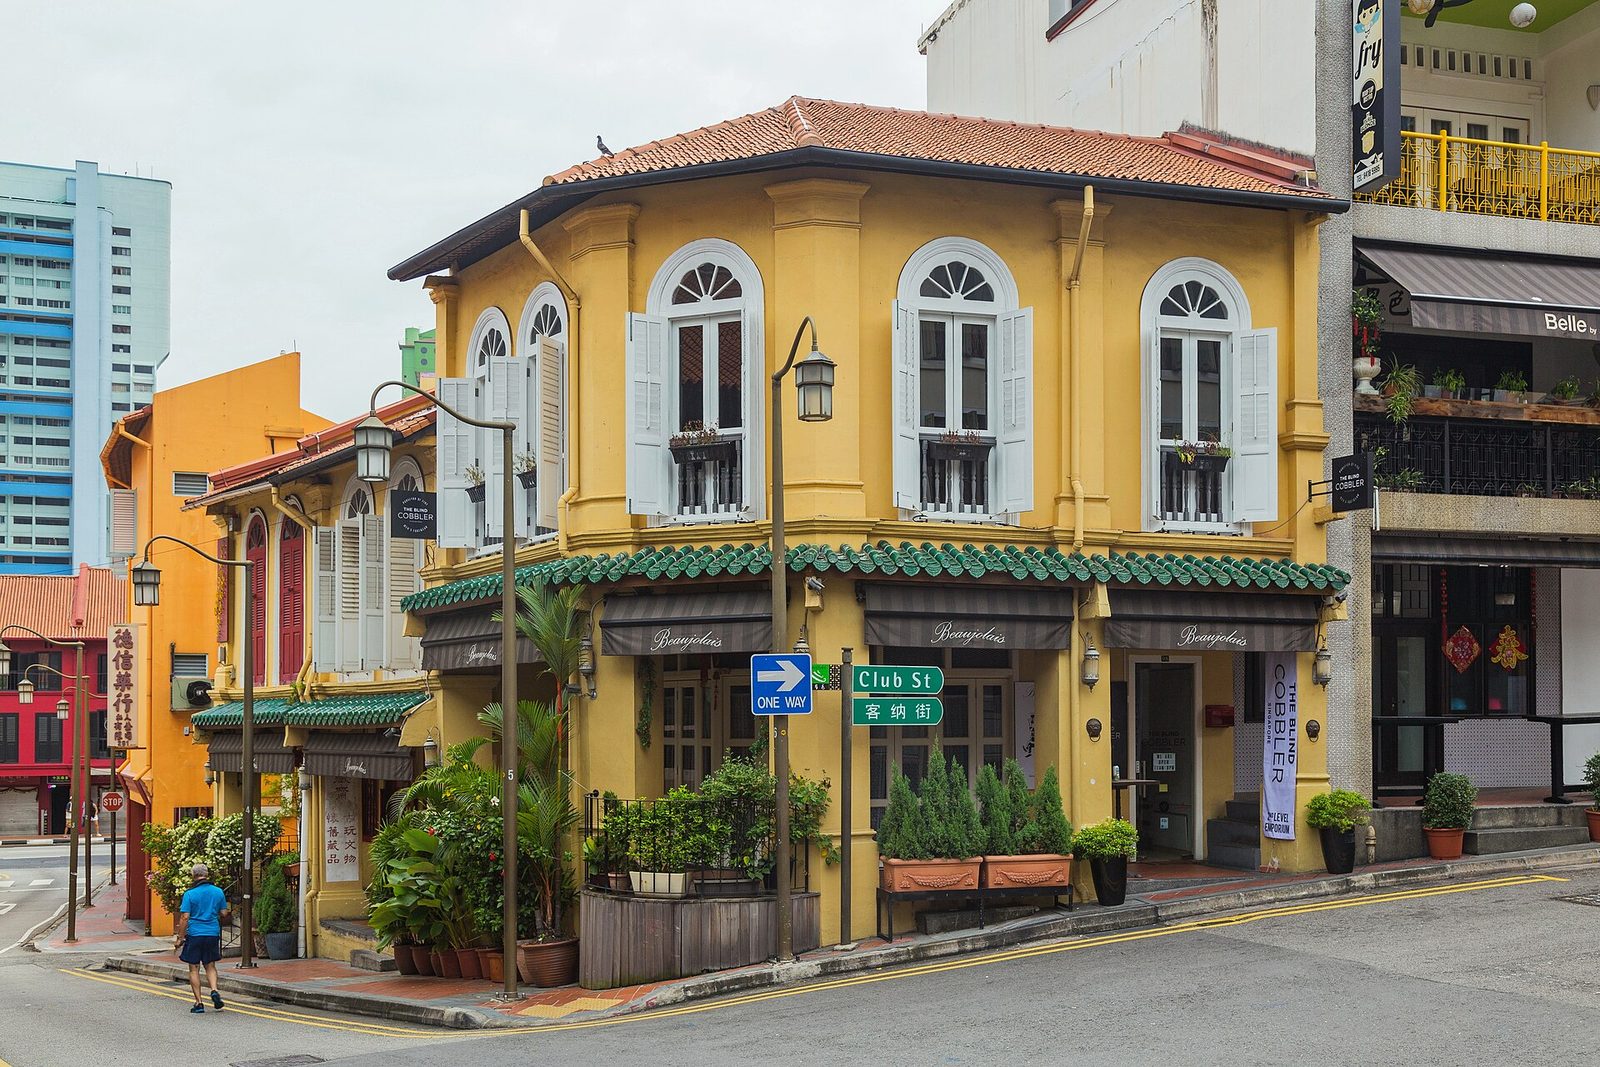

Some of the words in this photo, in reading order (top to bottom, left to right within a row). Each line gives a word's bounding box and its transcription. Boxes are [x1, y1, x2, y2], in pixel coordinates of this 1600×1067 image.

[1355, 39, 1382, 80] fry
[1544, 312, 1587, 333] Belle
[1589, 326, 1597, 335] by
[1335, 479, 1365, 491] COBBLER
[397, 512, 434, 521] COBBLER
[650, 627, 722, 652] Beaujolais
[930, 620, 1005, 646] Beaujolais
[1177, 624, 1247, 649] Beaujolais
[859, 671, 903, 688] Club
[911, 671, 931, 689] St
[757, 697, 780, 709] ONE
[785, 696, 807, 708] WAY
[1288, 682, 1297, 713] THE
[865, 703, 931, 720] 客纳街
[1271, 664, 1286, 784] COBBLER
[1288, 718, 1297, 765] BLIND
[507, 769, 514, 781] 5
[103, 798, 123, 806] STOP
[245, 805, 250, 814] 4
[1273, 812, 1289, 823] LEVEL
[1264, 823, 1290, 834] EMPORIUM
